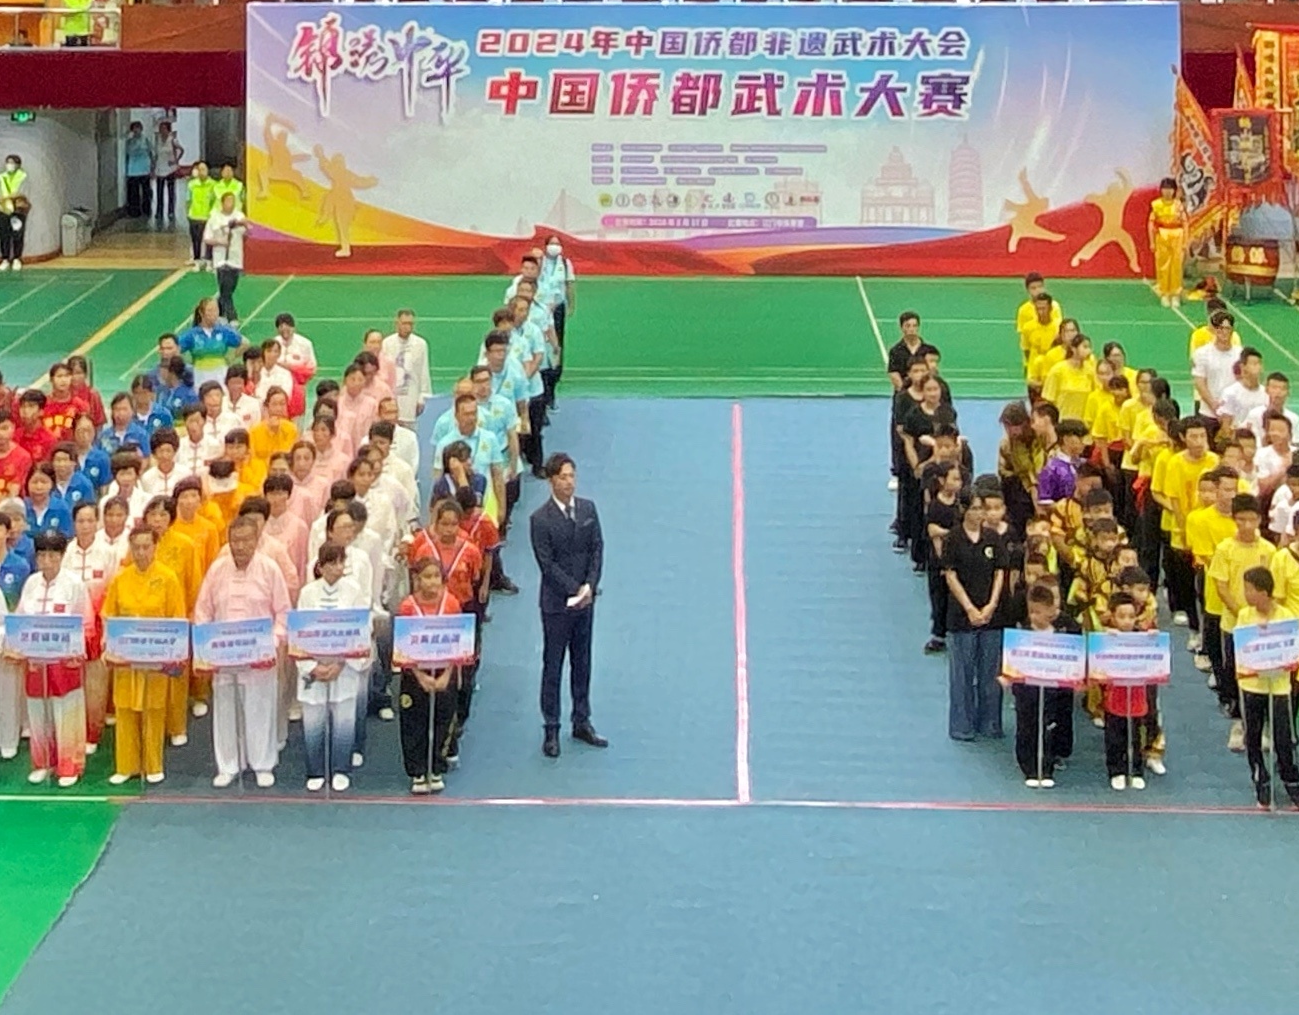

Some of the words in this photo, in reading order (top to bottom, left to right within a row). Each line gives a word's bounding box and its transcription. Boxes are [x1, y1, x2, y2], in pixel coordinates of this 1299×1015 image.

[478, 30, 967, 57] 2024年中国侨都非遗武术大会
[487, 71, 973, 117] 中国侨都武术大赛
